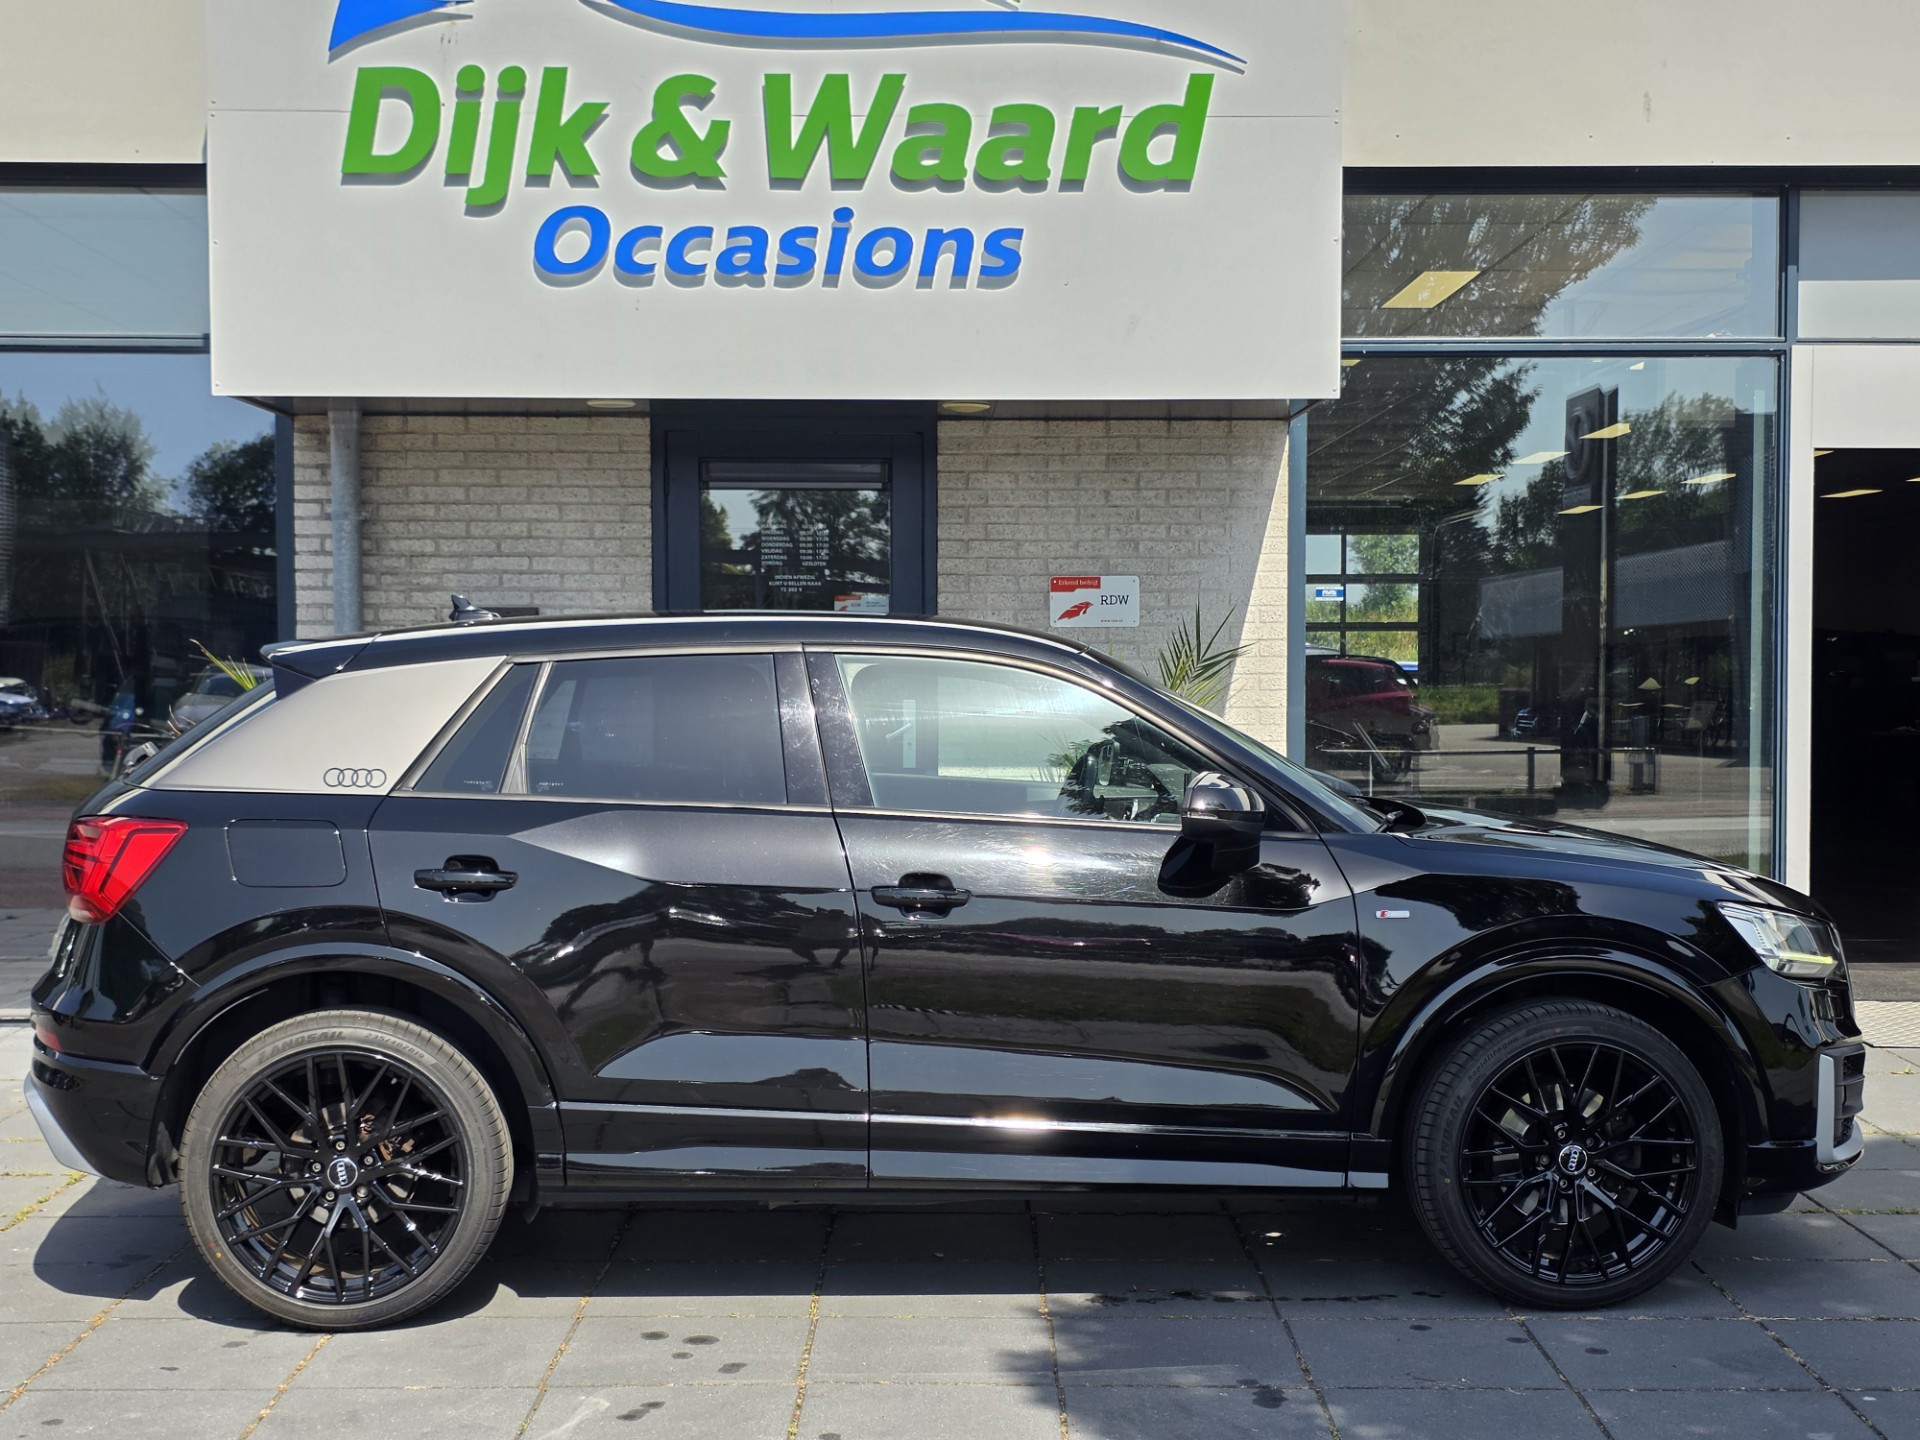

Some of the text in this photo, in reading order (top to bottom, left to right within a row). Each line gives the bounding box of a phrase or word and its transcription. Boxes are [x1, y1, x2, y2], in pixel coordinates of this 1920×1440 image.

[341, 66, 1214, 206] Dijk & Waard
[534, 205, 1024, 277] Occasions
[1100, 594, 1129, 606] RDW
